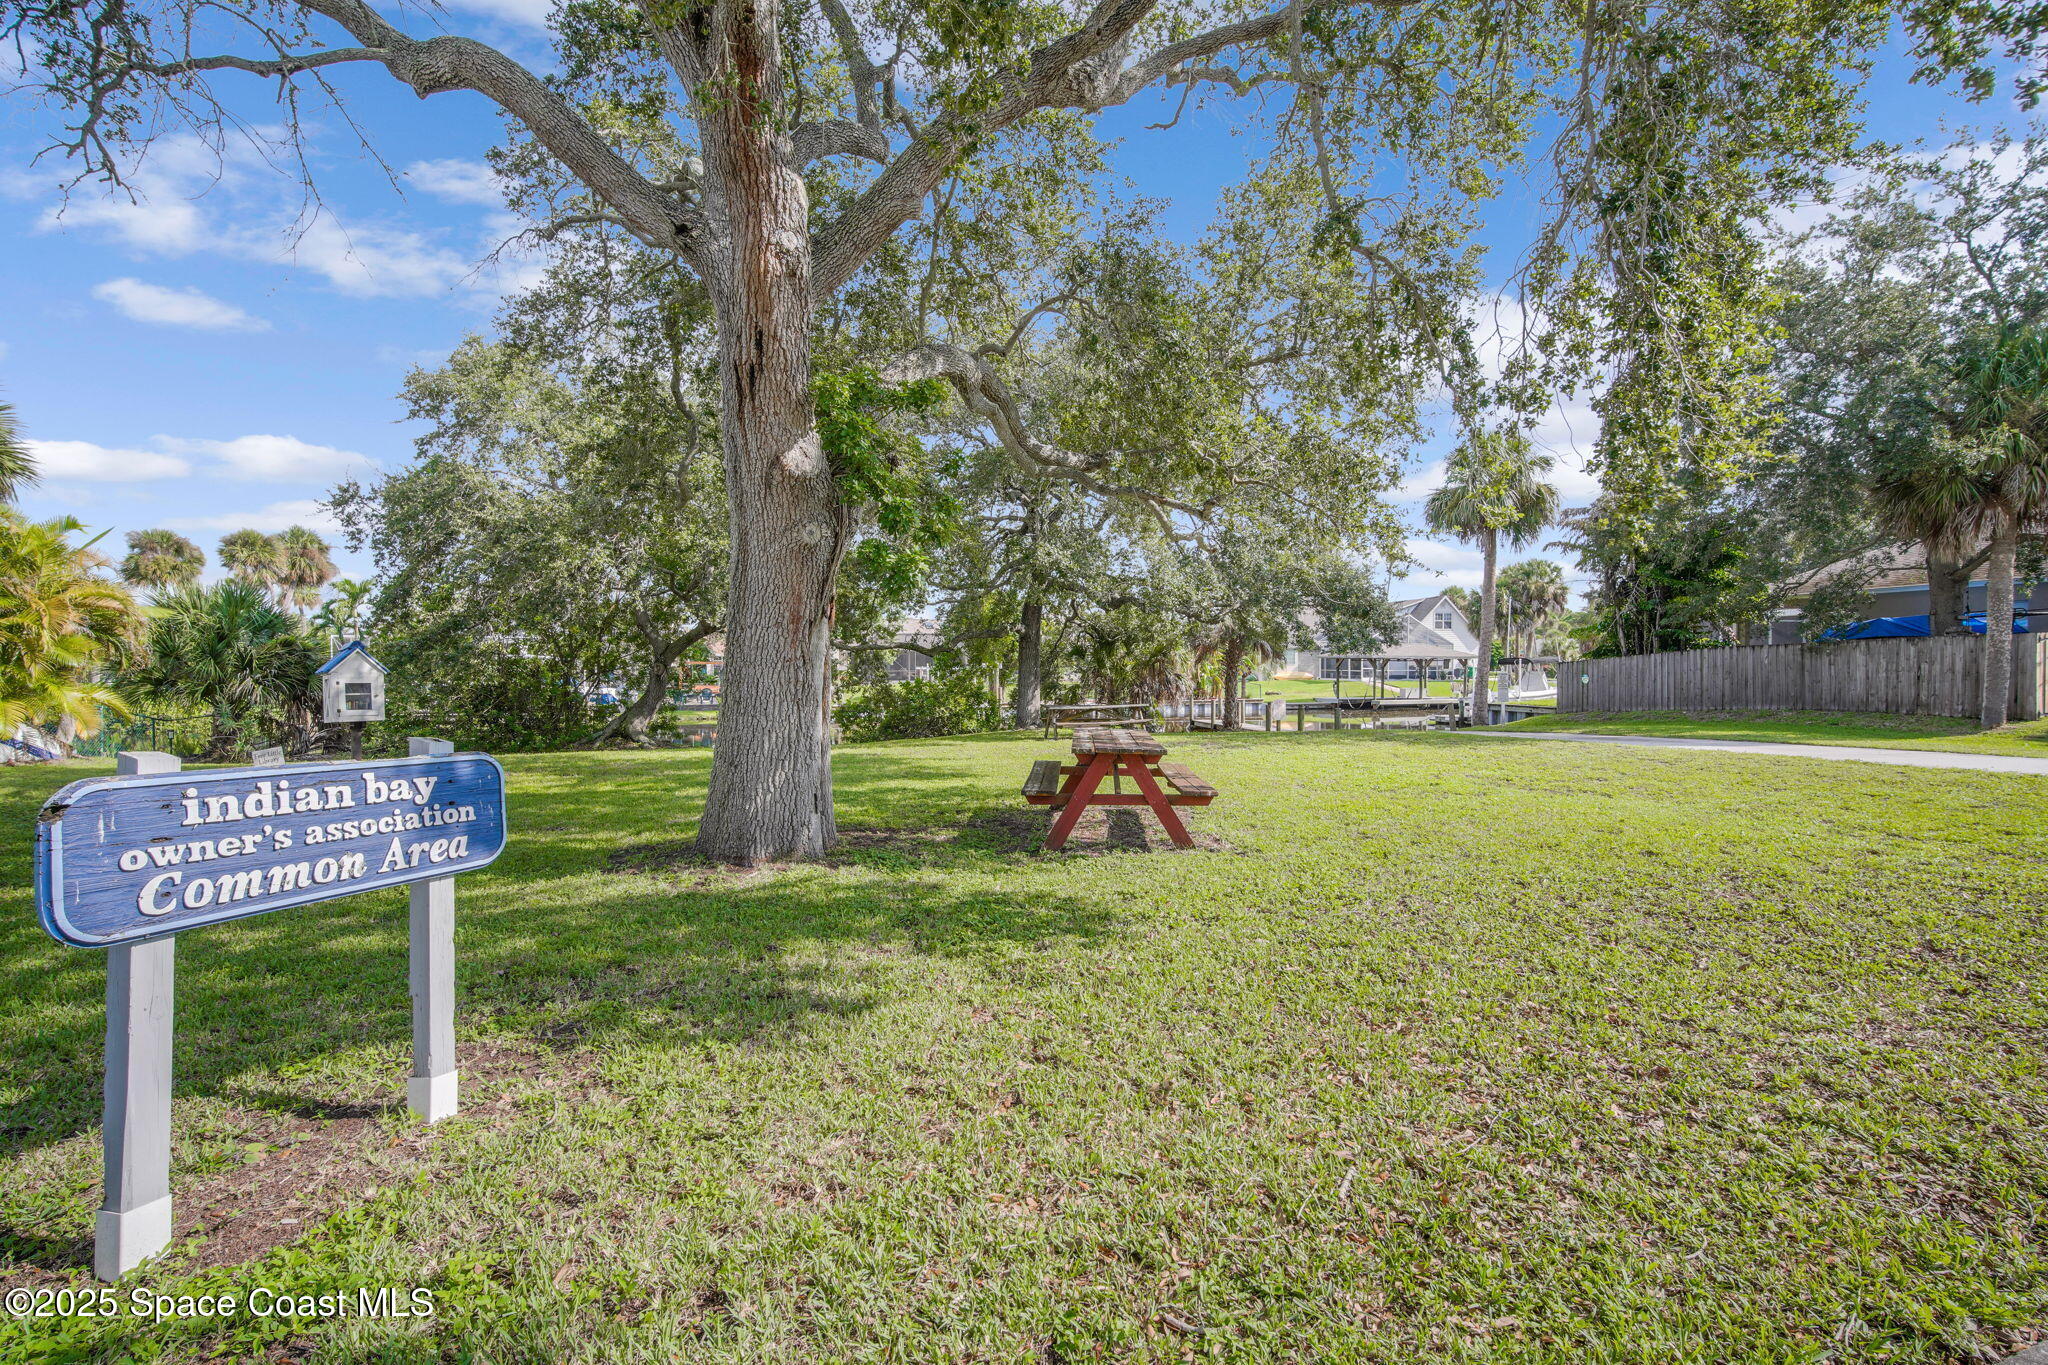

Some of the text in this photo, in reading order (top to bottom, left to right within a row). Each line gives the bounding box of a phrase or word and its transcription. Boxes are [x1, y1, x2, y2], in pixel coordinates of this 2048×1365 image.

[259, 757, 279, 765] Library
[267, 749, 281, 757] Little
[181, 771, 437, 826] indian bay
[119, 805, 476, 872] owner's association
[138, 835, 469, 916] Common Area
